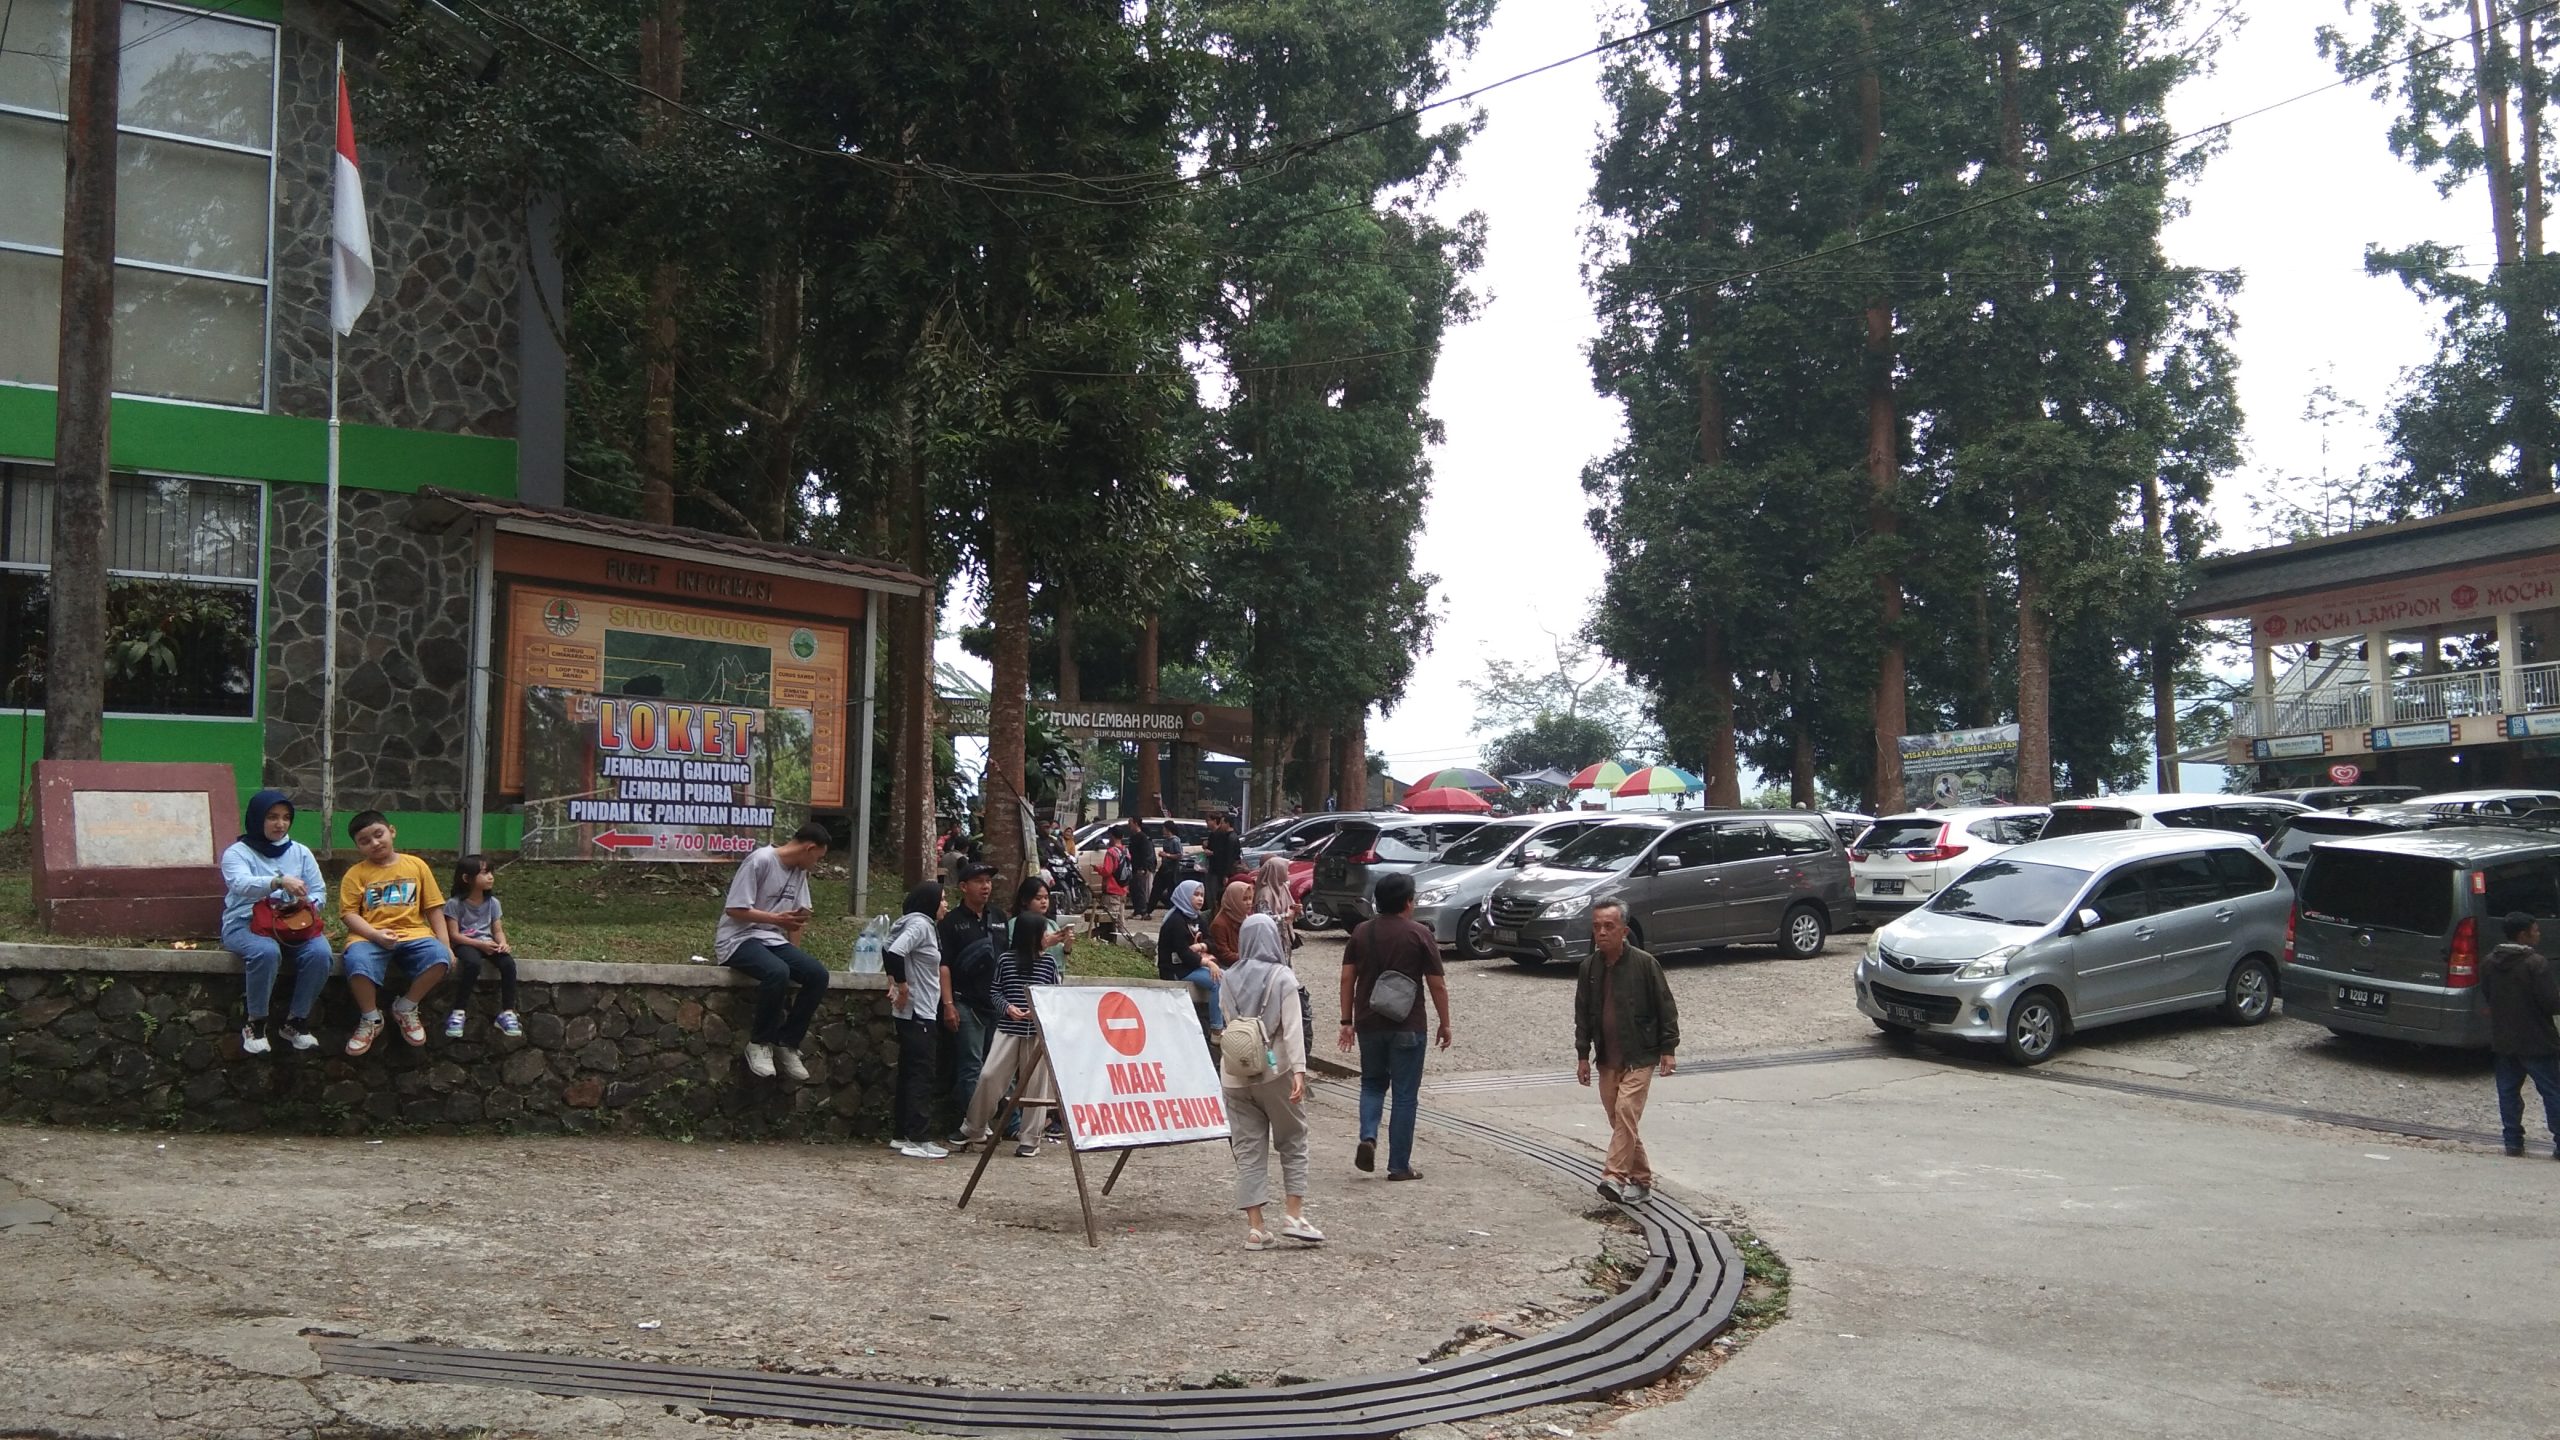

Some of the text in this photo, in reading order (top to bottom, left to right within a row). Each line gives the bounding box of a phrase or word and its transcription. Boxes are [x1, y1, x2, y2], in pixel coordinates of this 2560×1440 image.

[676, 570, 773, 602] INFORMASI
[2487, 580, 2553, 606] MOCHI
[609, 607, 768, 643] SITUGUNUNG
[2294, 613, 2349, 635] MOCHI
[2357, 598, 2441, 625] LAMPION
[599, 700, 754, 758] LOKET
[1091, 713, 1140, 728] LEMBAH
[1142, 714, 1184, 729] PURBA
[1093, 730, 1181, 739] SUKABUMI-INDONESIA
[1903, 741, 2017, 760] WISATA ALAM BERKELANJUTAN
[602, 757, 750, 783] JEMBATAN GANTUNG
[620, 780, 733, 803] LEMBAH PURBA
[570, 802, 774, 827] PINDAH KE PARKIRAN BARAT
[674, 834, 704, 849] 700
[708, 835, 755, 851] Meter
[2339, 987, 2345, 998] D
[2349, 989, 2368, 1002] 1203
[2373, 992, 2385, 1005] PX
[1106, 1062, 1167, 1095] MAAF
[1071, 1096, 1225, 1136] PARKIR PENUH
